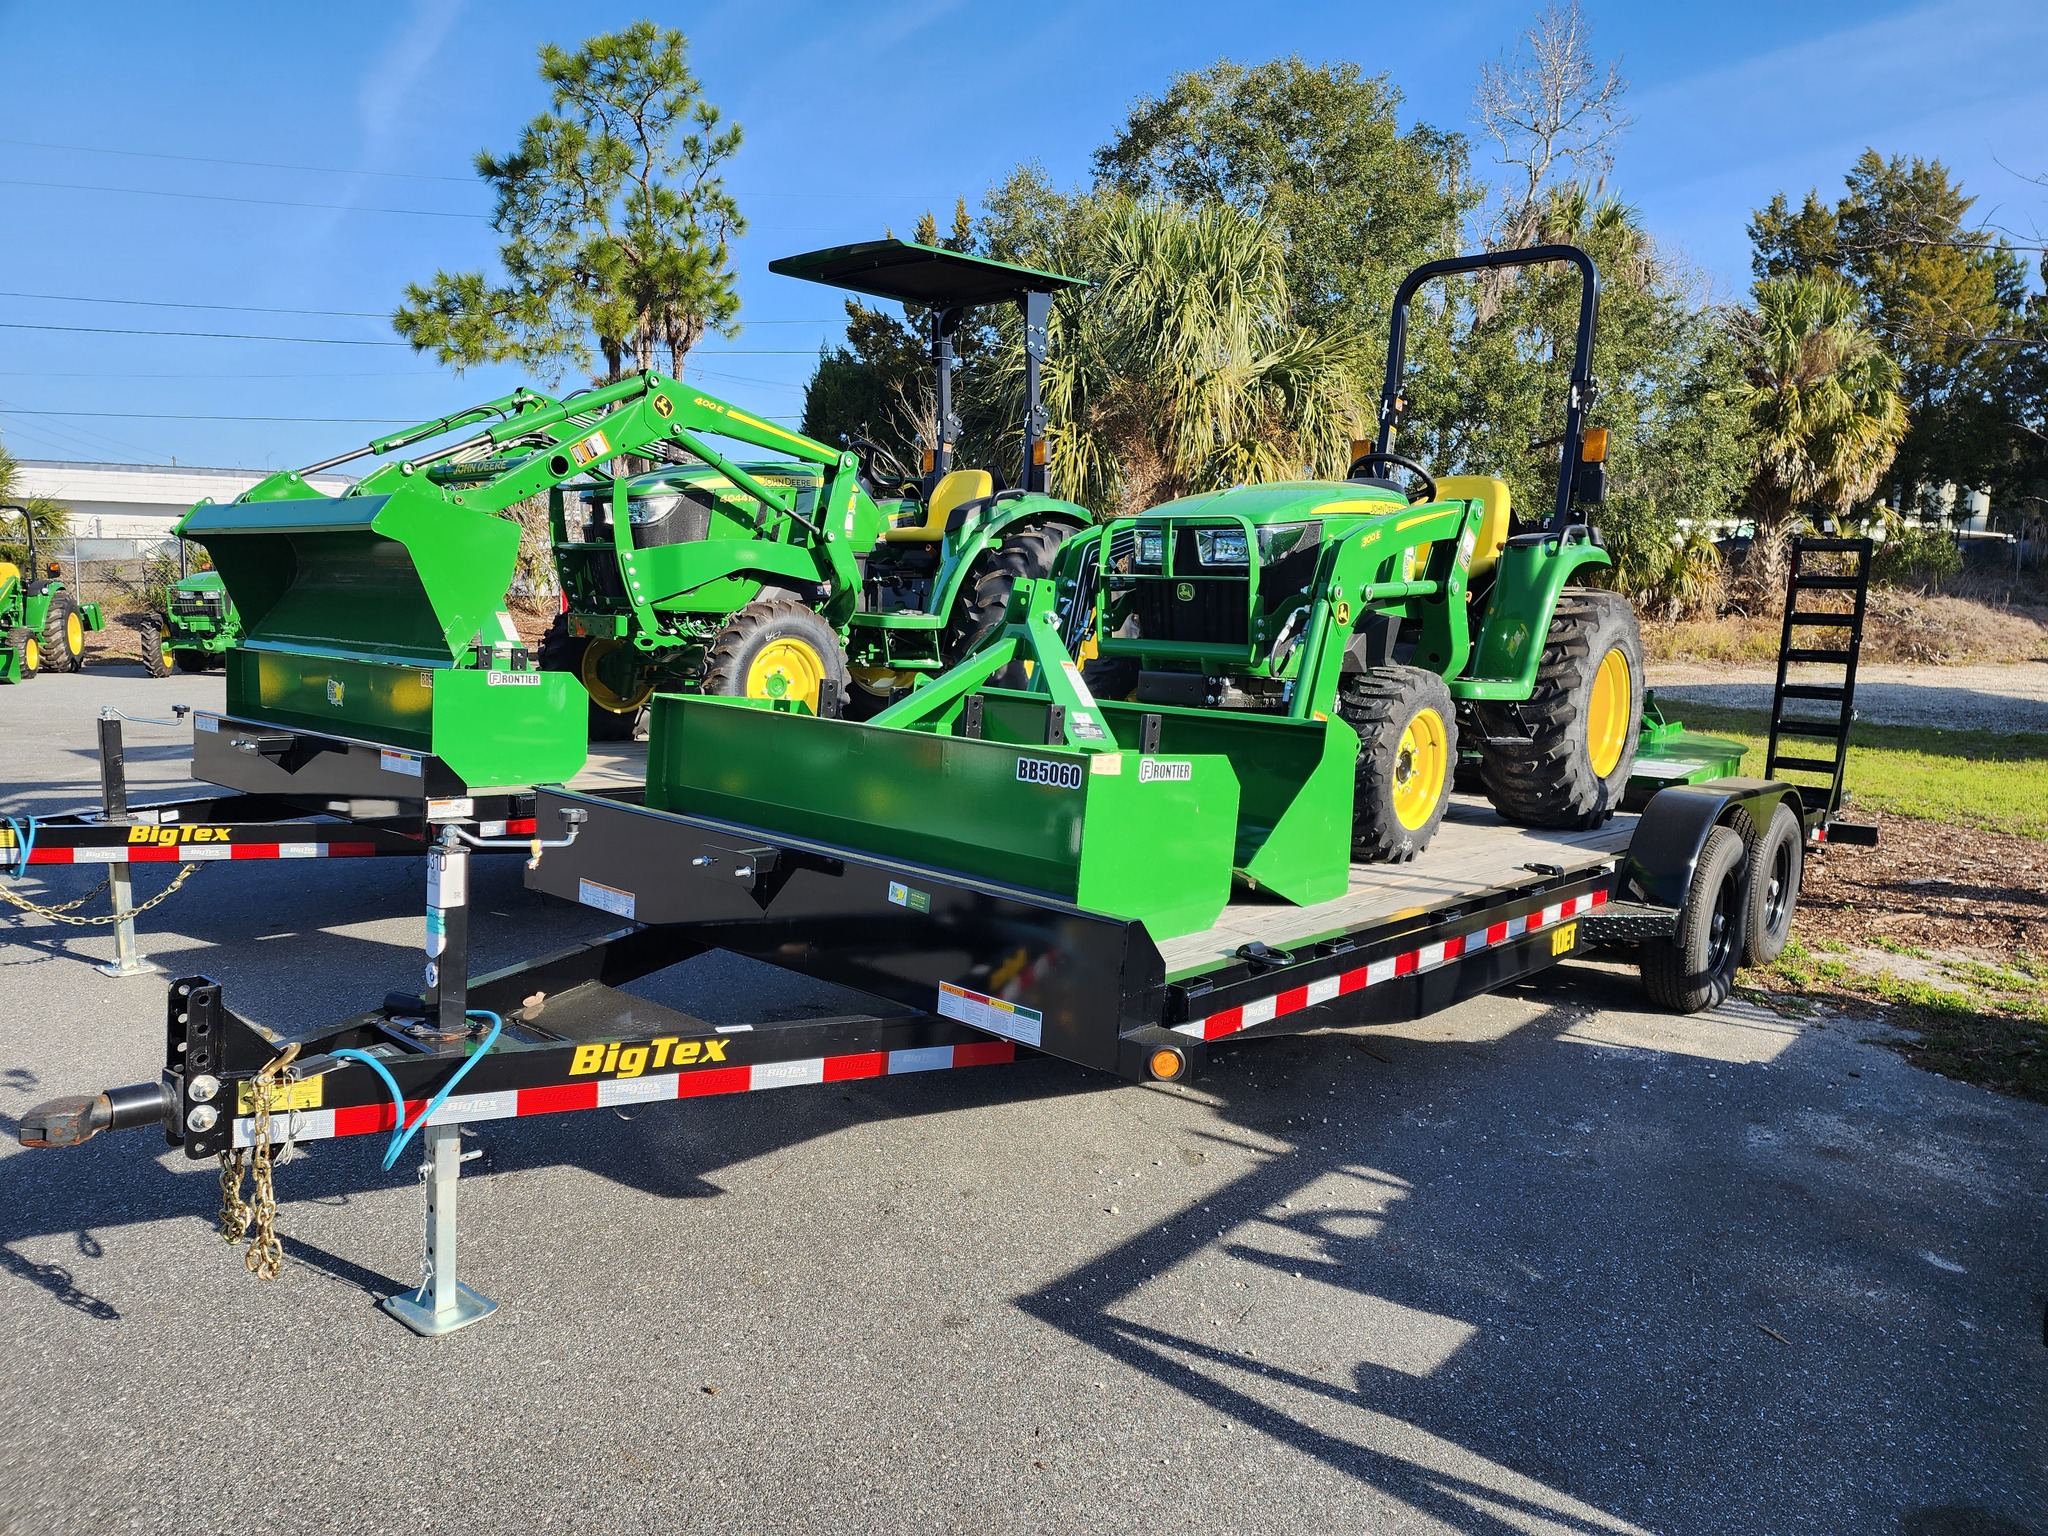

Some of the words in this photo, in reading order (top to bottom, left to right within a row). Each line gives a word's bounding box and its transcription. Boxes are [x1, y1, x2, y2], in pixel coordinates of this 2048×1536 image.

[453, 463, 476, 475] JOHN
[477, 460, 508, 472] DEERE
[489, 672, 539, 685] FRONTIER
[1017, 758, 1082, 788] BB5060
[1140, 760, 1191, 781] FRONTIER
[128, 825, 232, 847] BigTex
[427, 852, 447, 872] 310
[1552, 922, 1577, 956] 10ET
[568, 1037, 731, 1079] BigTex
[766, 1065, 808, 1077] BigTex
